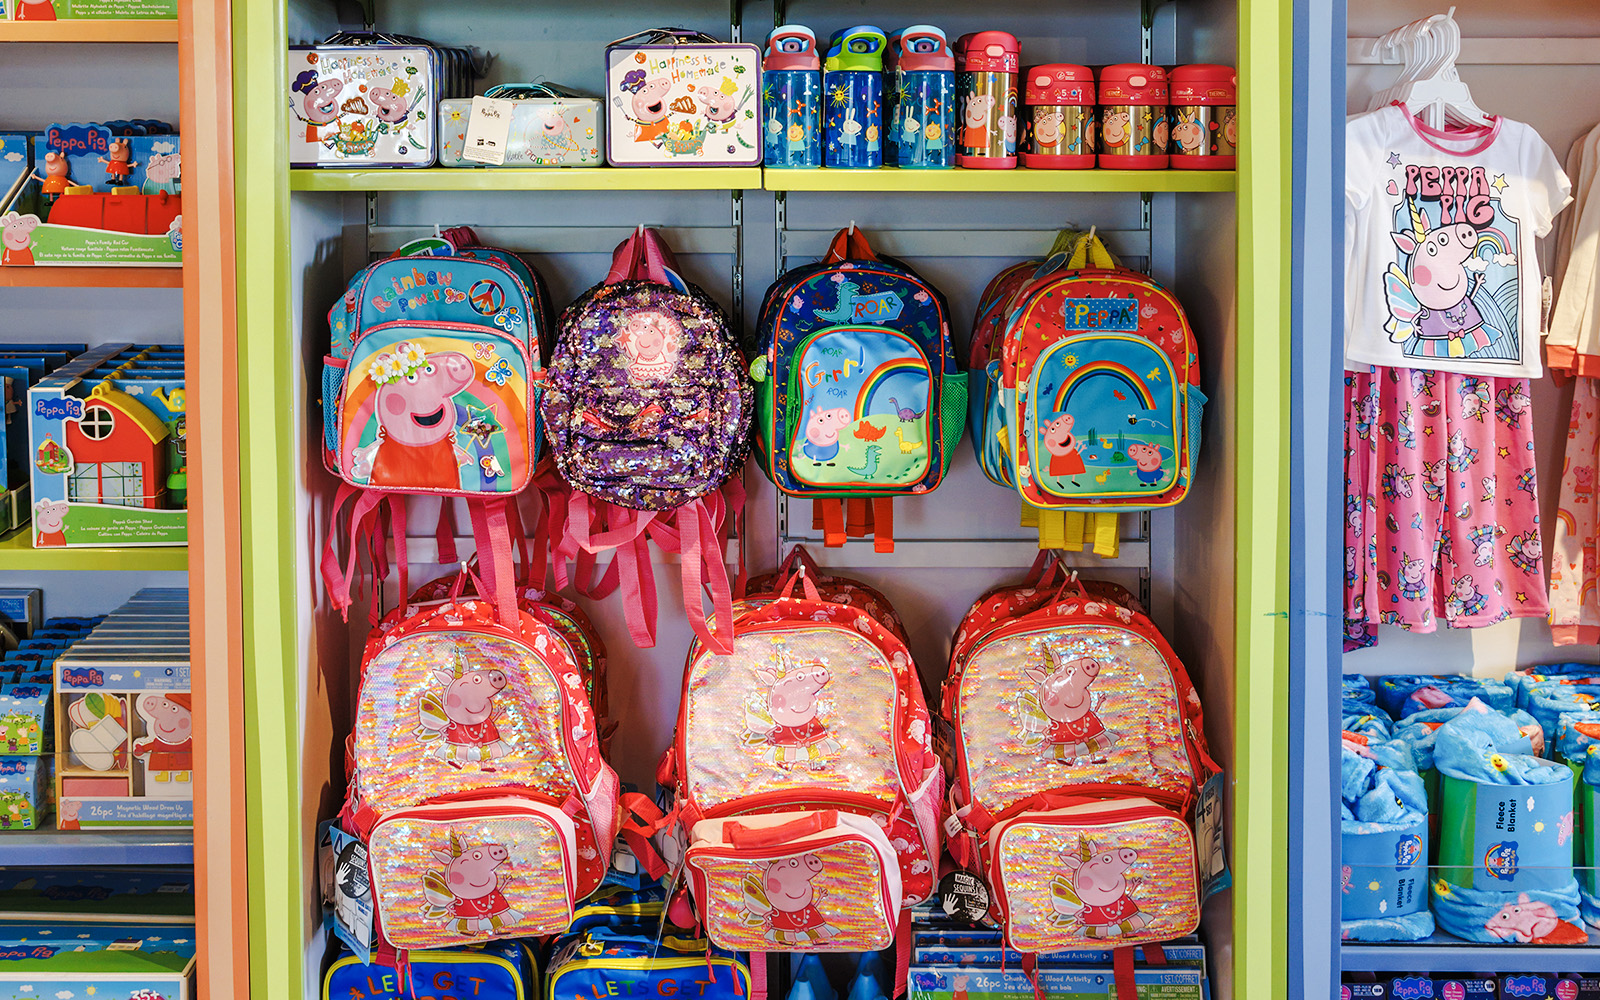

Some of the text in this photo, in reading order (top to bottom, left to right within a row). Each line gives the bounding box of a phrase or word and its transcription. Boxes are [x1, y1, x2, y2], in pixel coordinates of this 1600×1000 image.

[321, 56, 385, 75] Happiness is
[649, 54, 713, 74] Happiness is
[1156, 88, 1160, 96] 5
[50, 129, 108, 152] Peppa Pig
[1405, 165, 1491, 201] PEPPA
[1440, 195, 1495, 230] PIG
[371, 267, 453, 314] Rainbow
[854, 296, 898, 319] ROAR
[1075, 304, 1132, 328] PEPPA
[38, 400, 80, 417] Peppa Pig
[64, 670, 89, 686] Peppa
[88, 670, 104, 686] Pig
[90, 806, 114, 820] 26pc
[116, 804, 142, 812] Magnetic
[128, 812, 156, 820] d'habillage
[1496, 801, 1506, 830] Fleece
[1508, 799, 1517, 832] Blanket
[1396, 878, 1406, 908] Blanket
[1407, 878, 1415, 904] Fleece
[32, 946, 54, 958] Pig
[432, 971, 486, 996] GET
[592, 978, 710, 1000] LETS GET
[976, 977, 1001, 991] 26pc
[1004, 974, 1027, 982] Chunky
[1066, 976, 1092, 984] Activity
[1395, 980, 1431, 997] Peppa Pig
[1507, 978, 1544, 994] Peppa Pig
